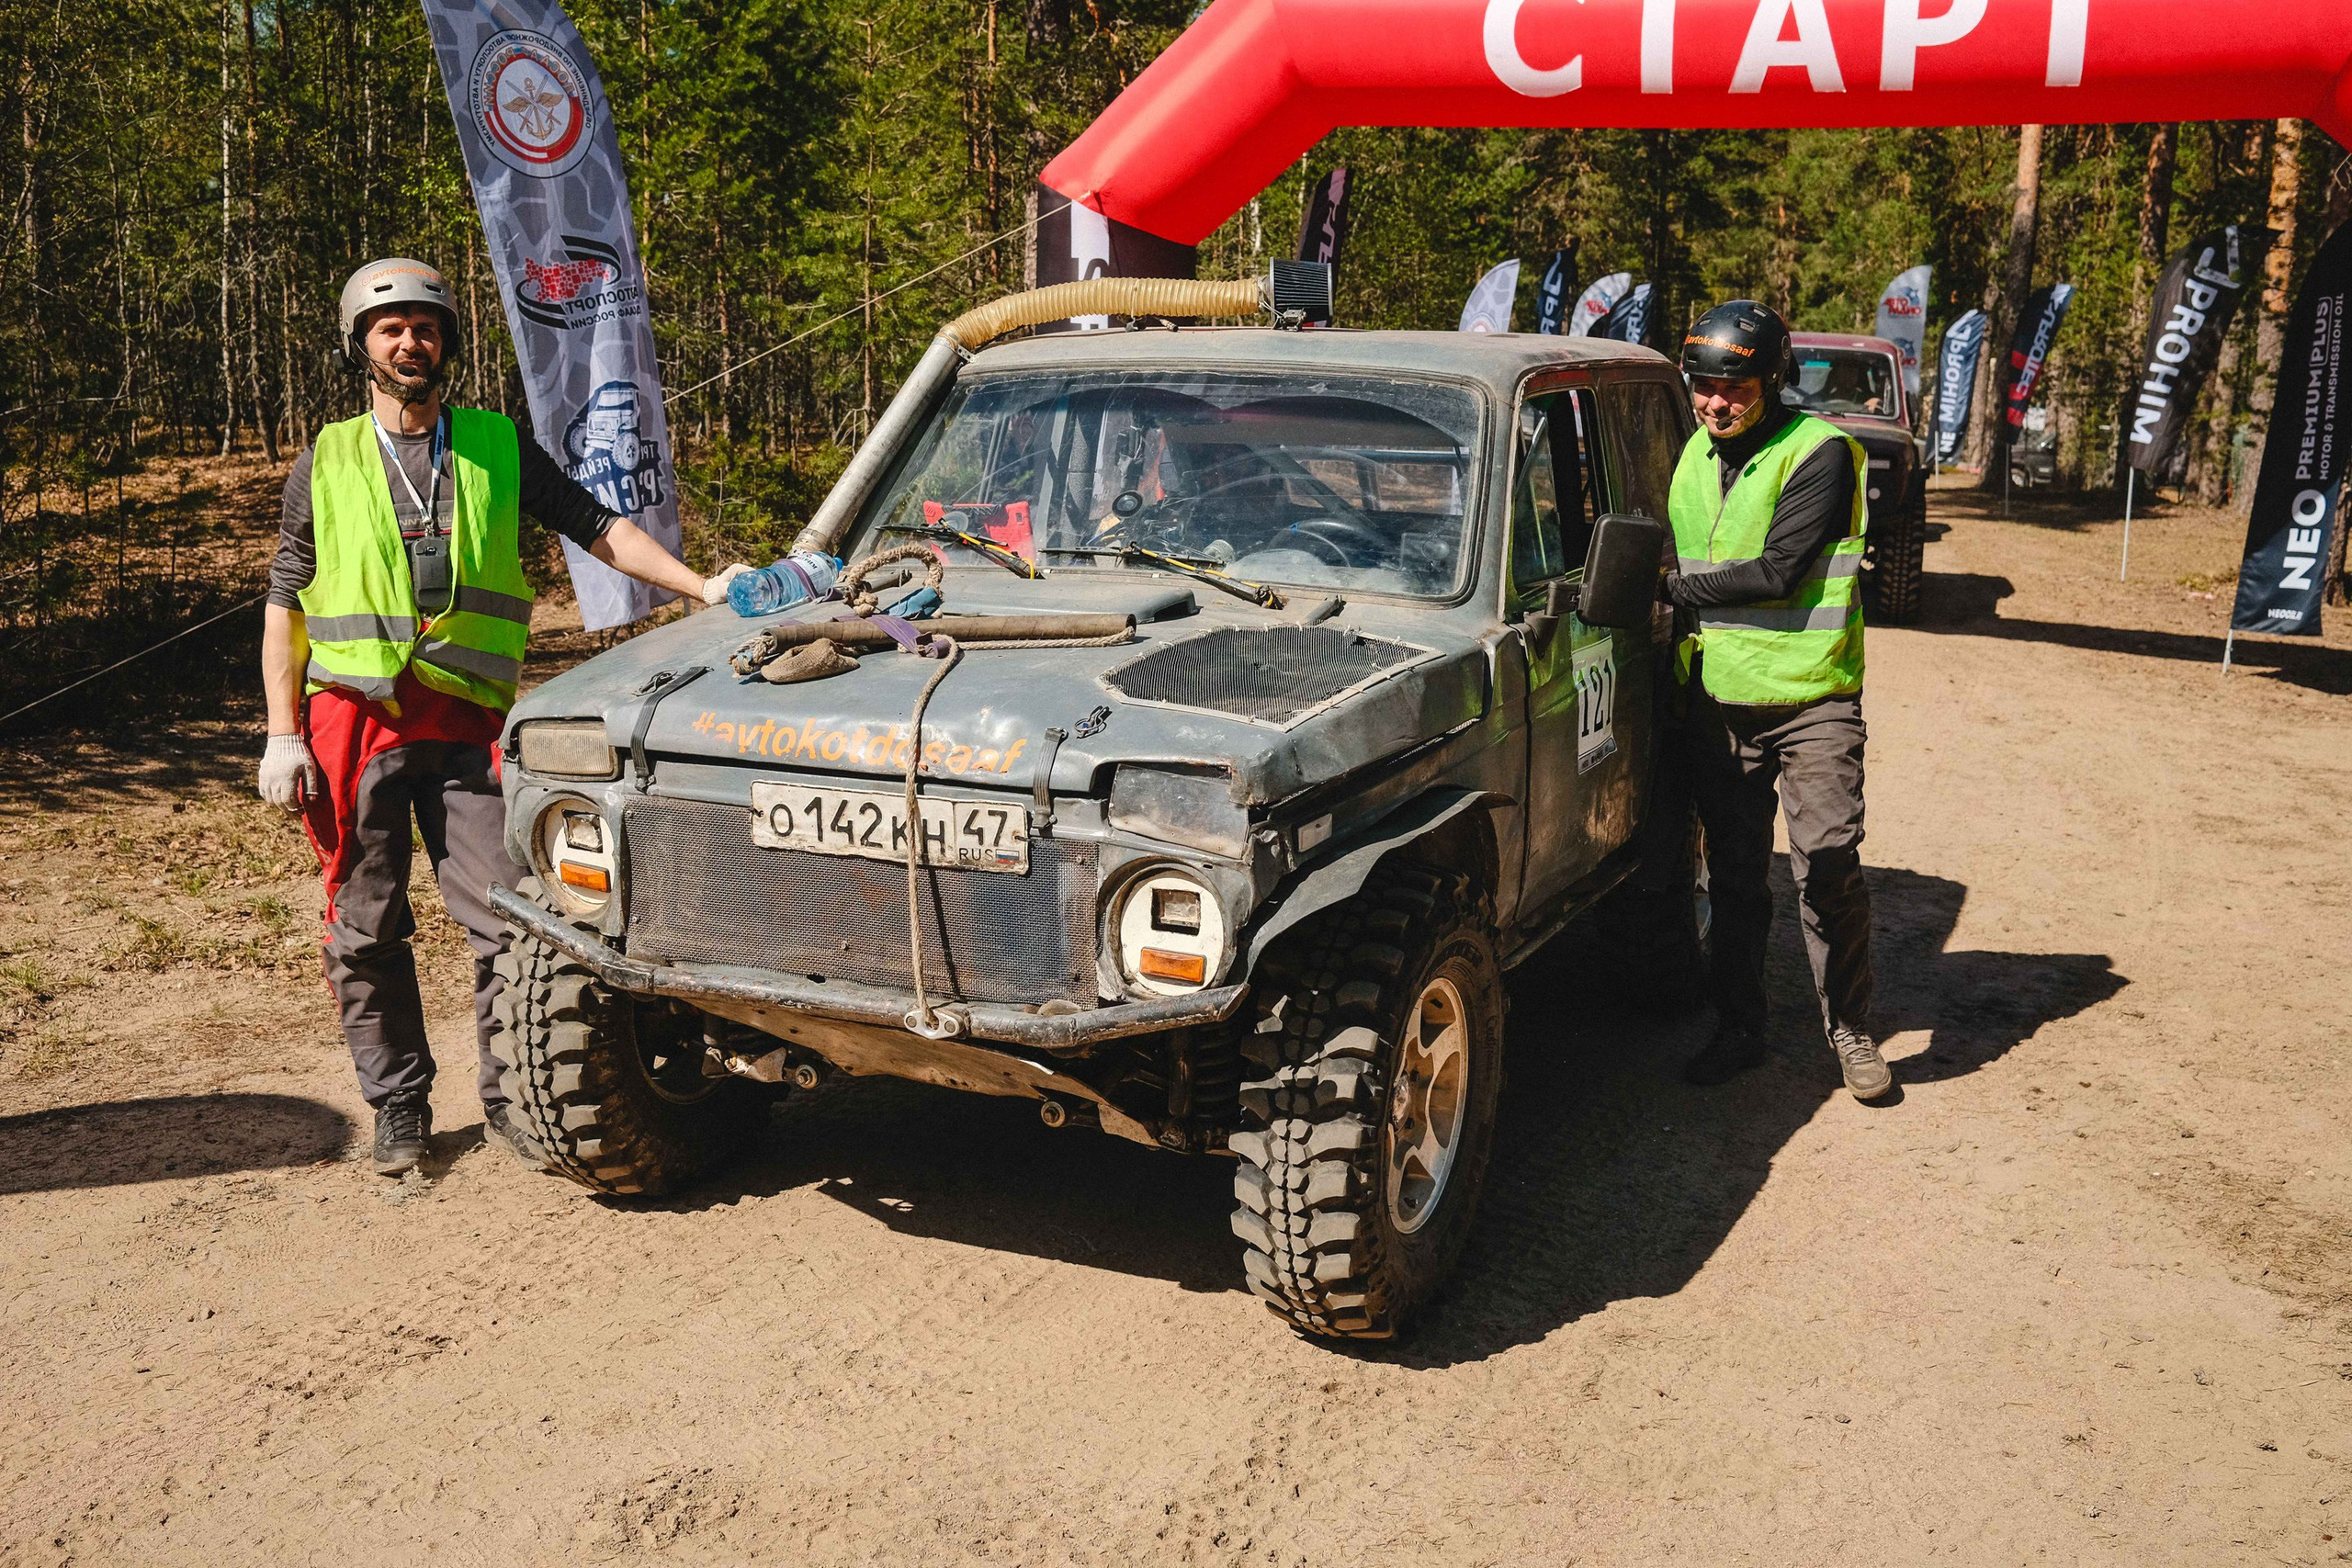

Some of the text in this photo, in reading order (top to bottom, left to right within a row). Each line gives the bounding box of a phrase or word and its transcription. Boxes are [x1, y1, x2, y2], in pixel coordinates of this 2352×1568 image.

[2334, 293, 2345, 320] OIL
[2129, 277, 2219, 446] PROHIM
[2324, 321, 2344, 423] TRANSMISSION
[2278, 302, 2329, 591] NEO PREMIUM PLUS
[2319, 440, 2334, 480] MOTOR
[1578, 659, 1613, 738] 121
[958, 847, 994, 863] RUS
[962, 808, 1009, 847] 47
